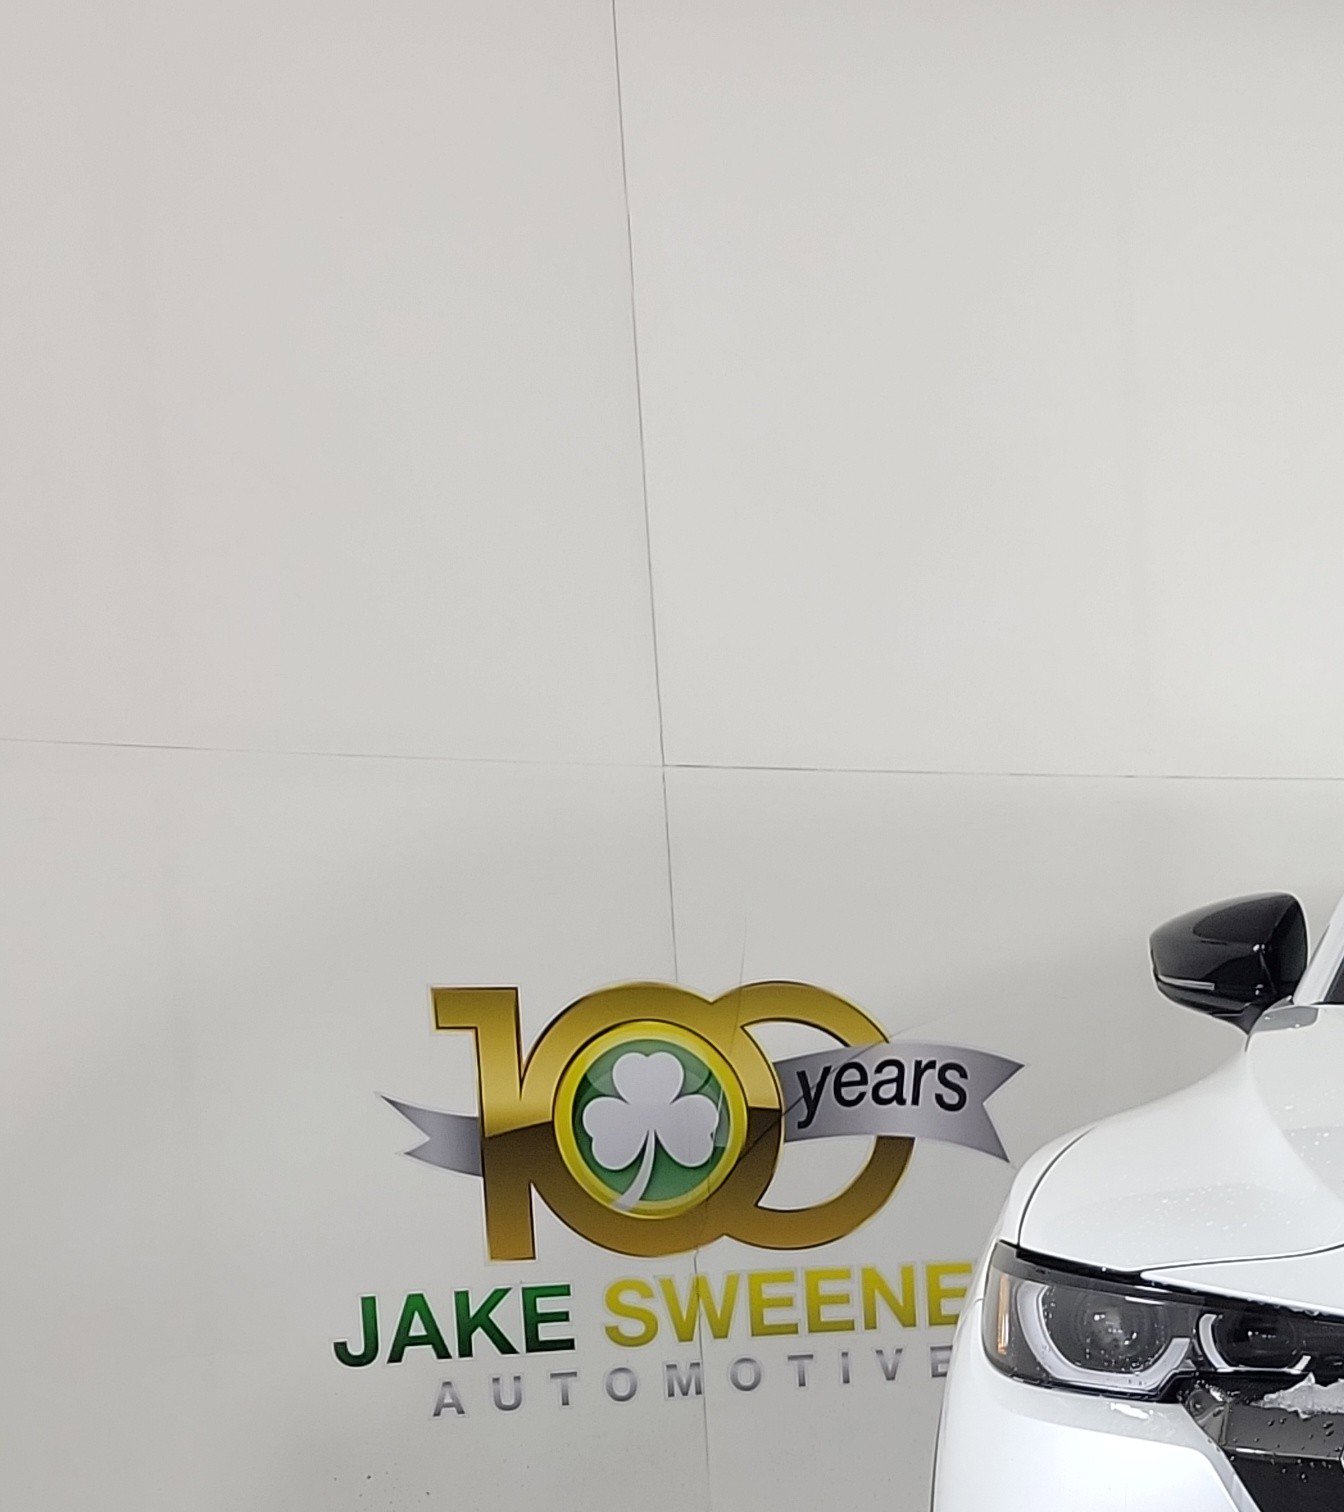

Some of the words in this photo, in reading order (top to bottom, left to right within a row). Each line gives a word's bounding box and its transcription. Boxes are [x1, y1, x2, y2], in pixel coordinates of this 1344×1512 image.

[430, 980, 916, 1261] 100
[796, 1056, 969, 1129] years
[333, 1284, 576, 1368] JAKE
[603, 1262, 975, 1349] SWEENE
[432, 1345, 953, 1418] AUTOMOTIVE
